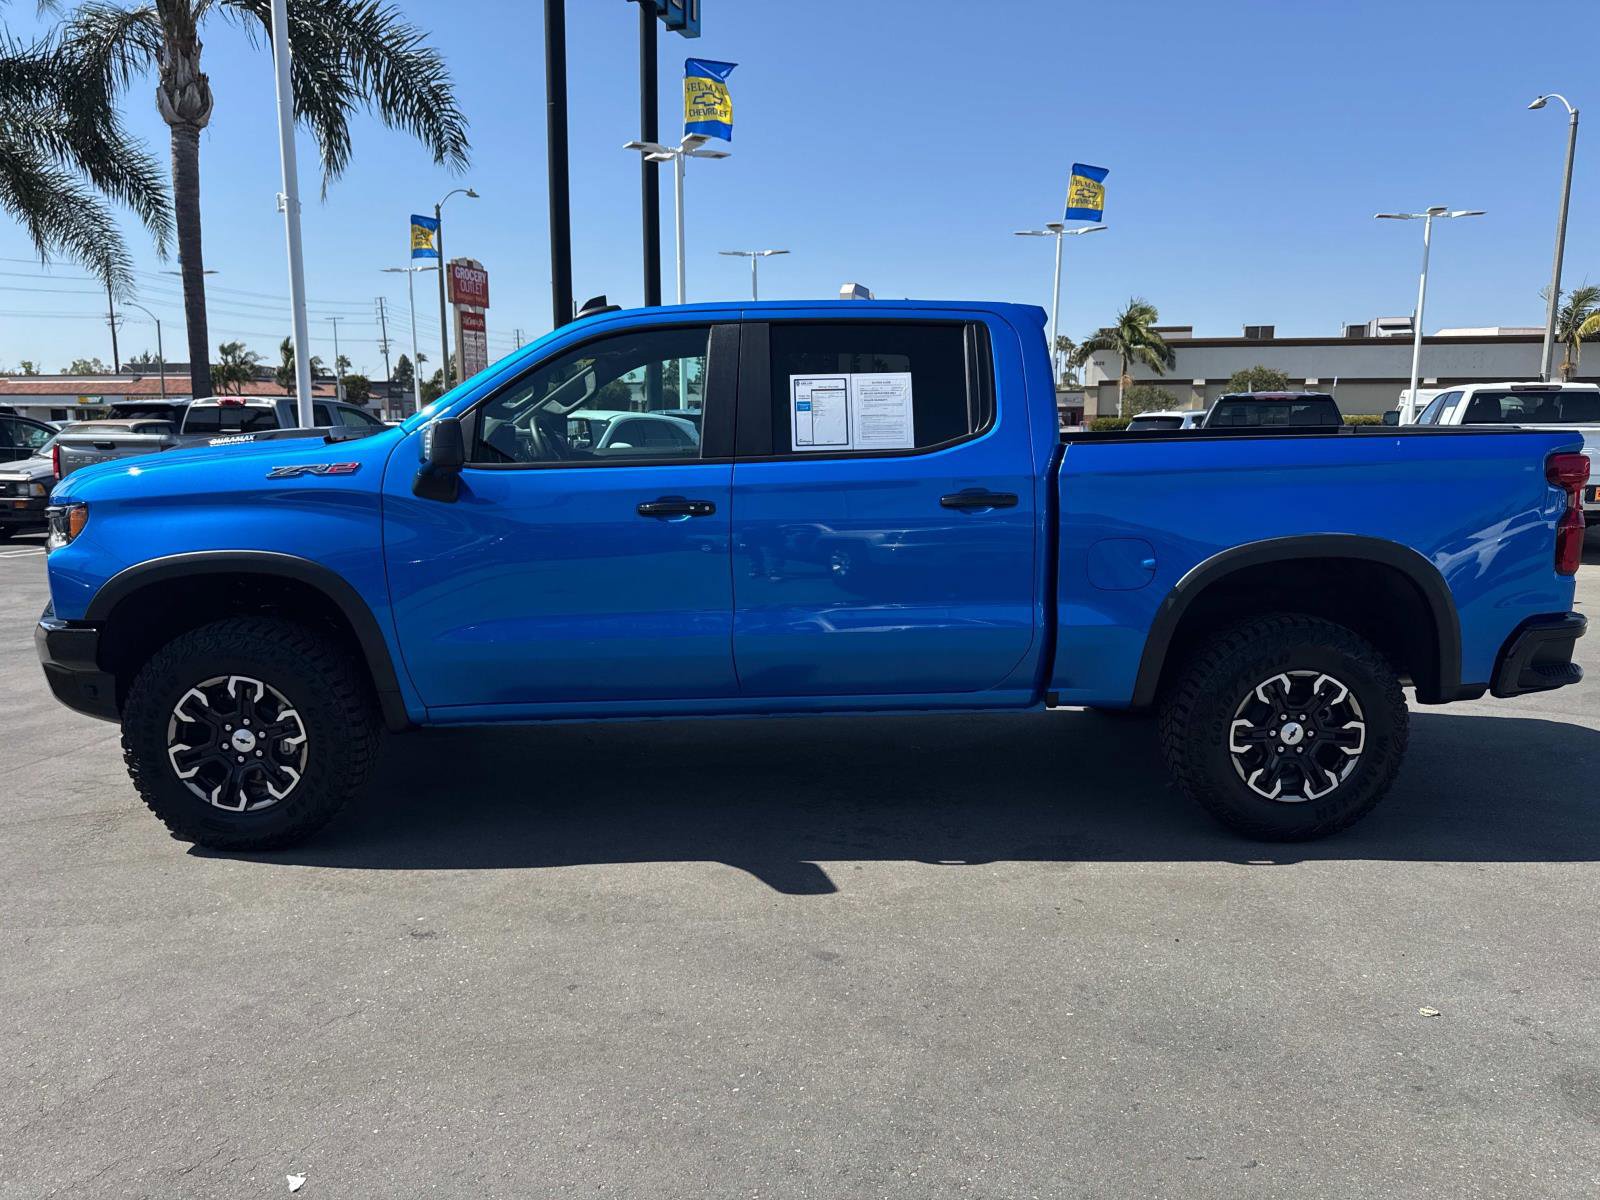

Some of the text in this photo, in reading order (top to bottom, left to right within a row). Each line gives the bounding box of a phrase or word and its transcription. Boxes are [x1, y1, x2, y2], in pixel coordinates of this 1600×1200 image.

[455, 266, 486, 284] GROCERY
[460, 280, 482, 295] OUTLET
[208, 434, 255, 445] DURAMAX
[266, 462, 361, 479] ZR2
